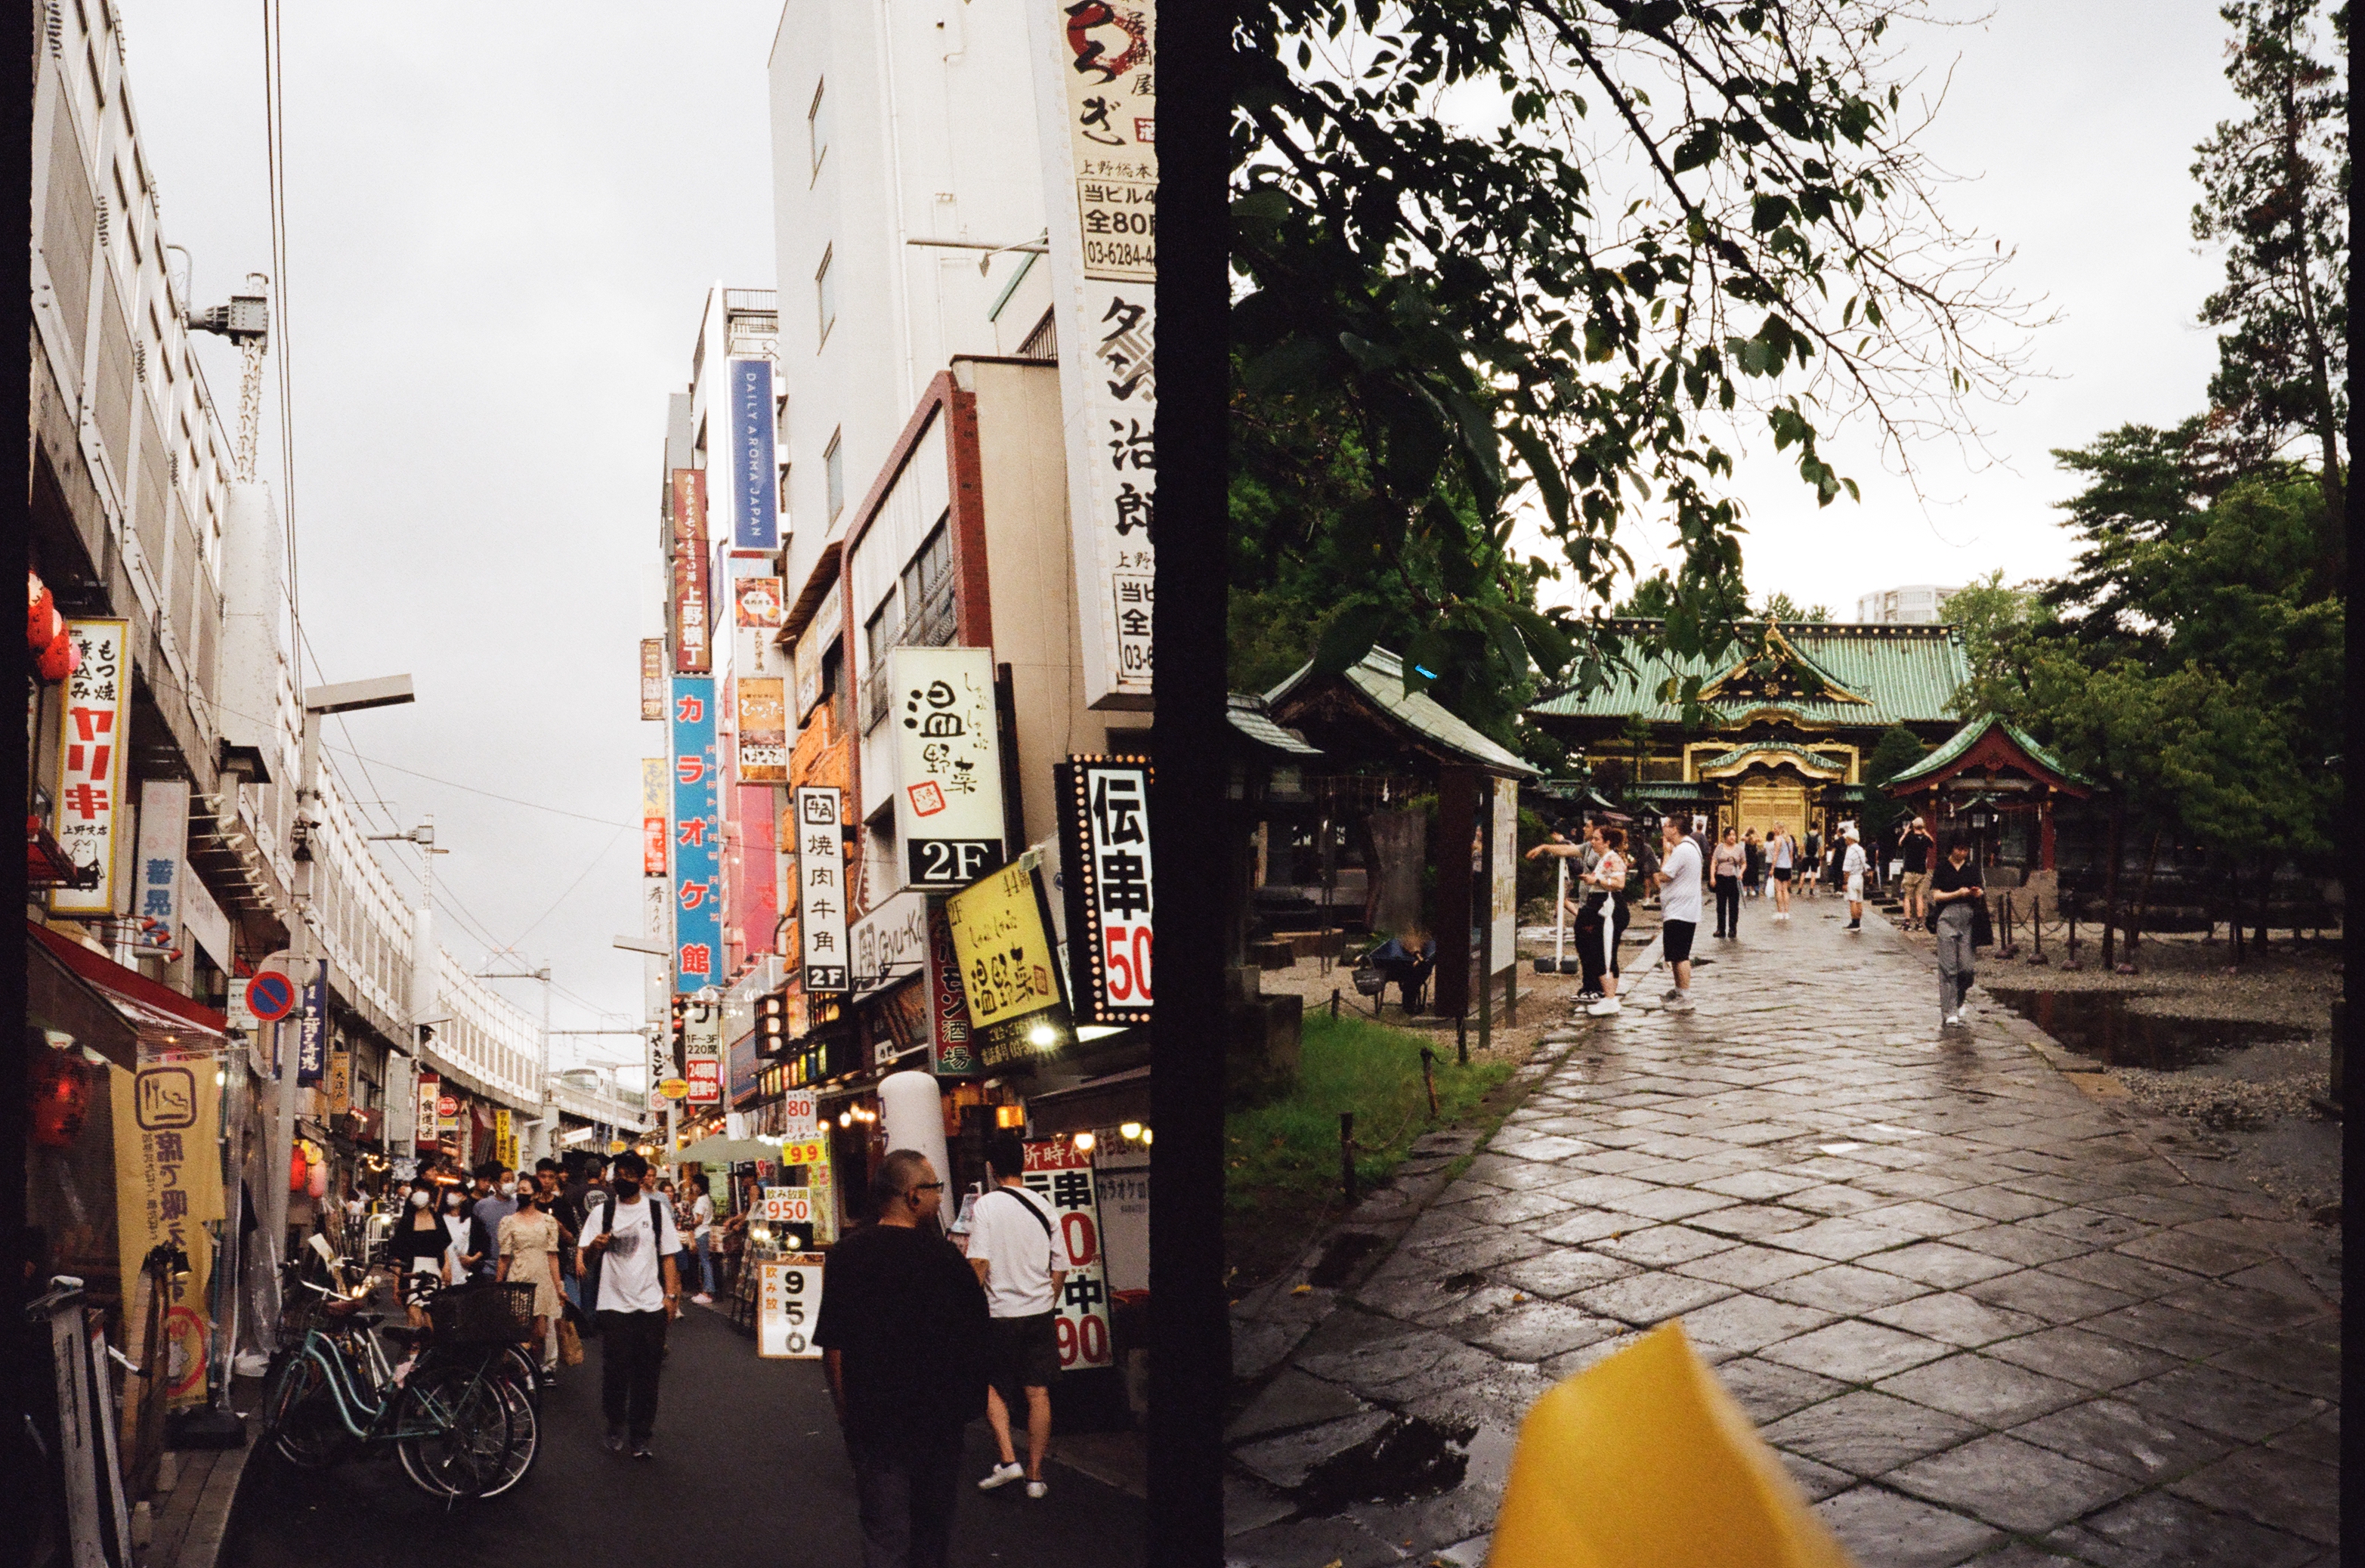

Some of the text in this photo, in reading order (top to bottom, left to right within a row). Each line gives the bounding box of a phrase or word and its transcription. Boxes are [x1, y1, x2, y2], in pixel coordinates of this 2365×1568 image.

[1080, 159, 1158, 178] 上野総本
[1086, 209, 1155, 235] 全80
[745, 373, 762, 537] DAILY AROMA JAPAN
[682, 584, 703, 666] 上野横丁
[94, 640, 116, 700] もつ焼
[904, 679, 978, 795] 温野菜
[706, 744, 718, 861] KARAOKE
[63, 824, 107, 836] 上野支店
[677, 695, 711, 976] カラオケ館
[923, 841, 990, 880] 2F
[1093, 776, 1153, 920] 伝串
[808, 834, 836, 954] 焼肉牛角
[811, 968, 842, 985] 2F
[938, 916, 972, 1069] ルモン酒場
[687, 1045, 718, 1055] 220席
[689, 1062, 717, 1078] 24時間
[689, 1081, 717, 1097] 営業中
[787, 1099, 811, 1117] 80
[790, 1144, 818, 1163] 99
[766, 1189, 808, 1200] 飲み放題
[767, 1201, 808, 1220] 950
[784, 1270, 806, 1354] 950
